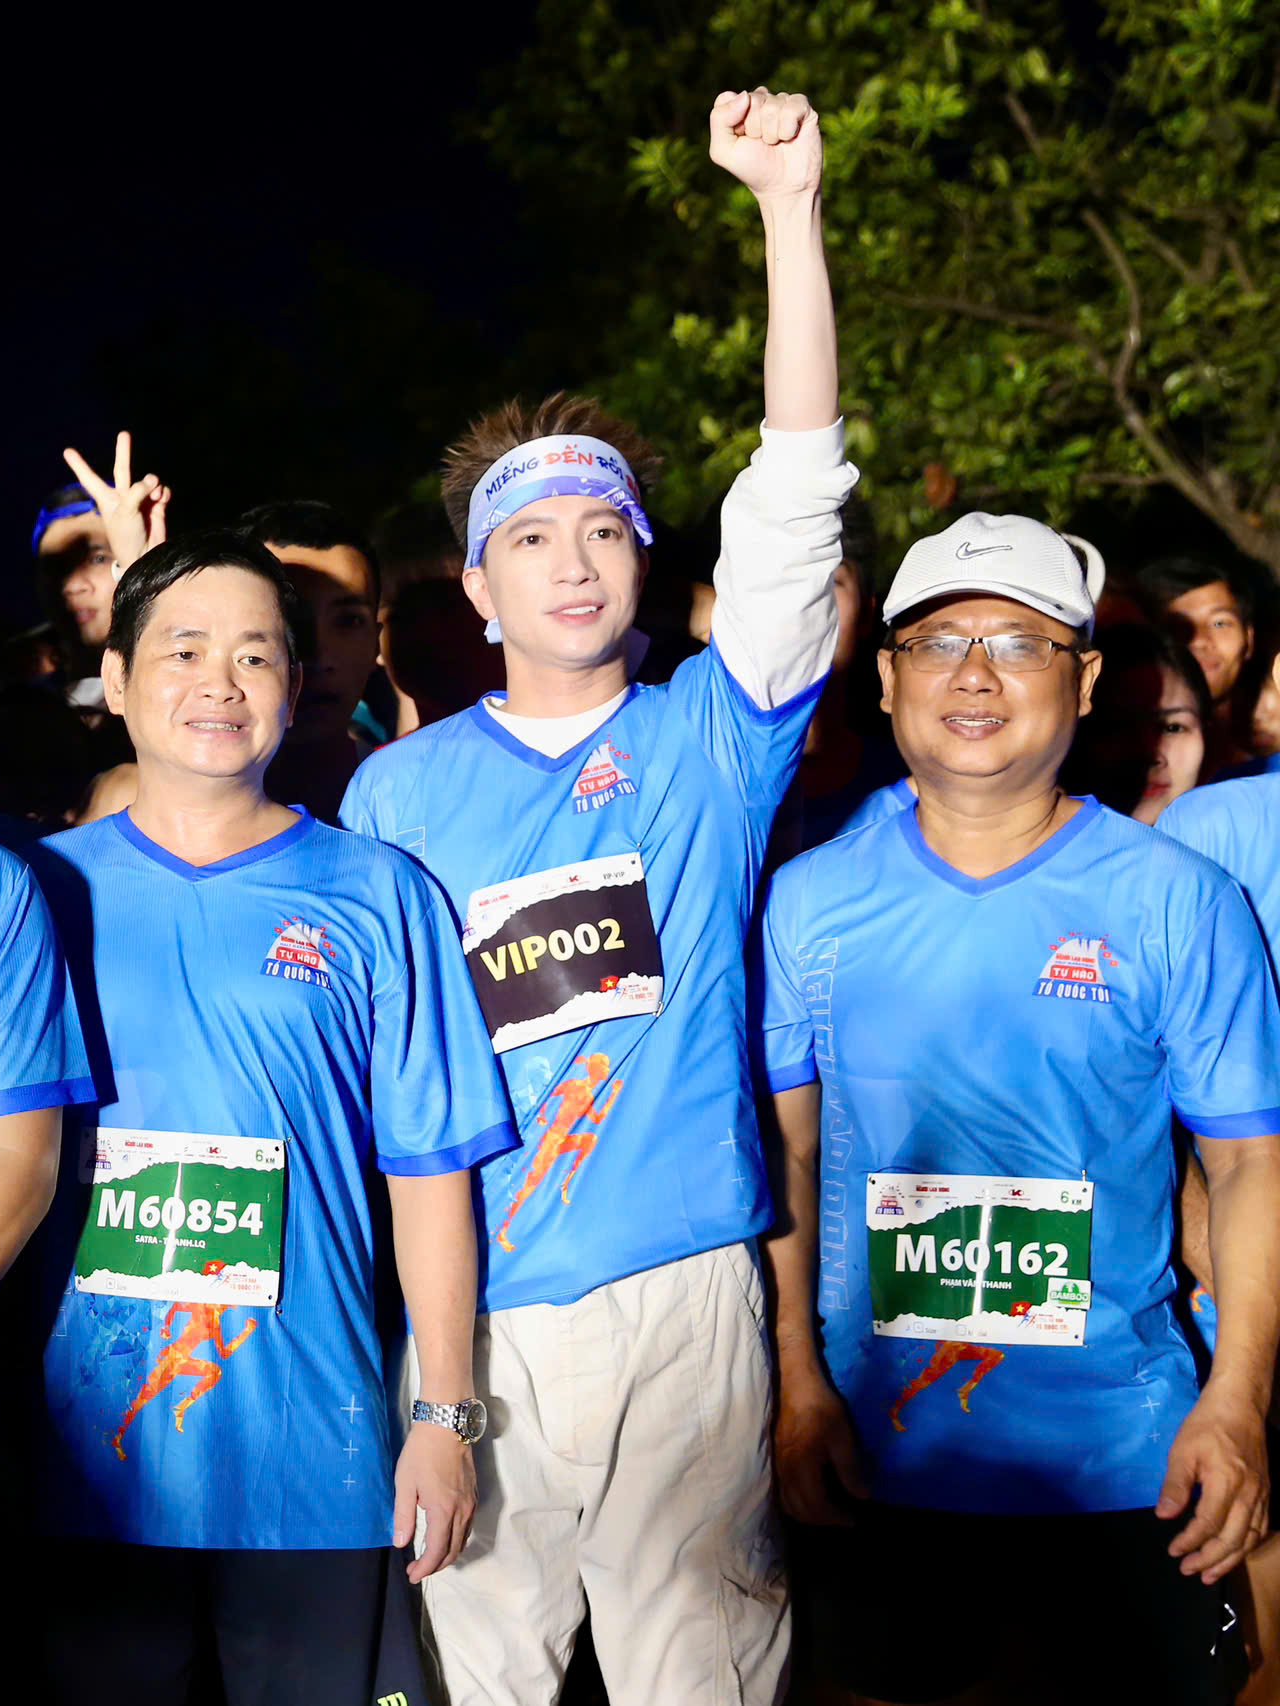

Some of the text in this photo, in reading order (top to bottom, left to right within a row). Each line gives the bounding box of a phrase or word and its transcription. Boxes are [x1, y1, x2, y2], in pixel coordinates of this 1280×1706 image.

[480, 918, 625, 982] VIP002
[255, 1149, 263, 1162] 6
[1060, 1191, 1069, 1204] 6
[96, 1188, 264, 1236] M60854
[135, 1235, 158, 1244] SATRA
[163, 1237, 206, 1249] TANH.LQ
[895, 1234, 1069, 1276] M60162
[982, 1280, 1012, 1290] THANH
[1050, 1291, 1089, 1302] BAMBOO
